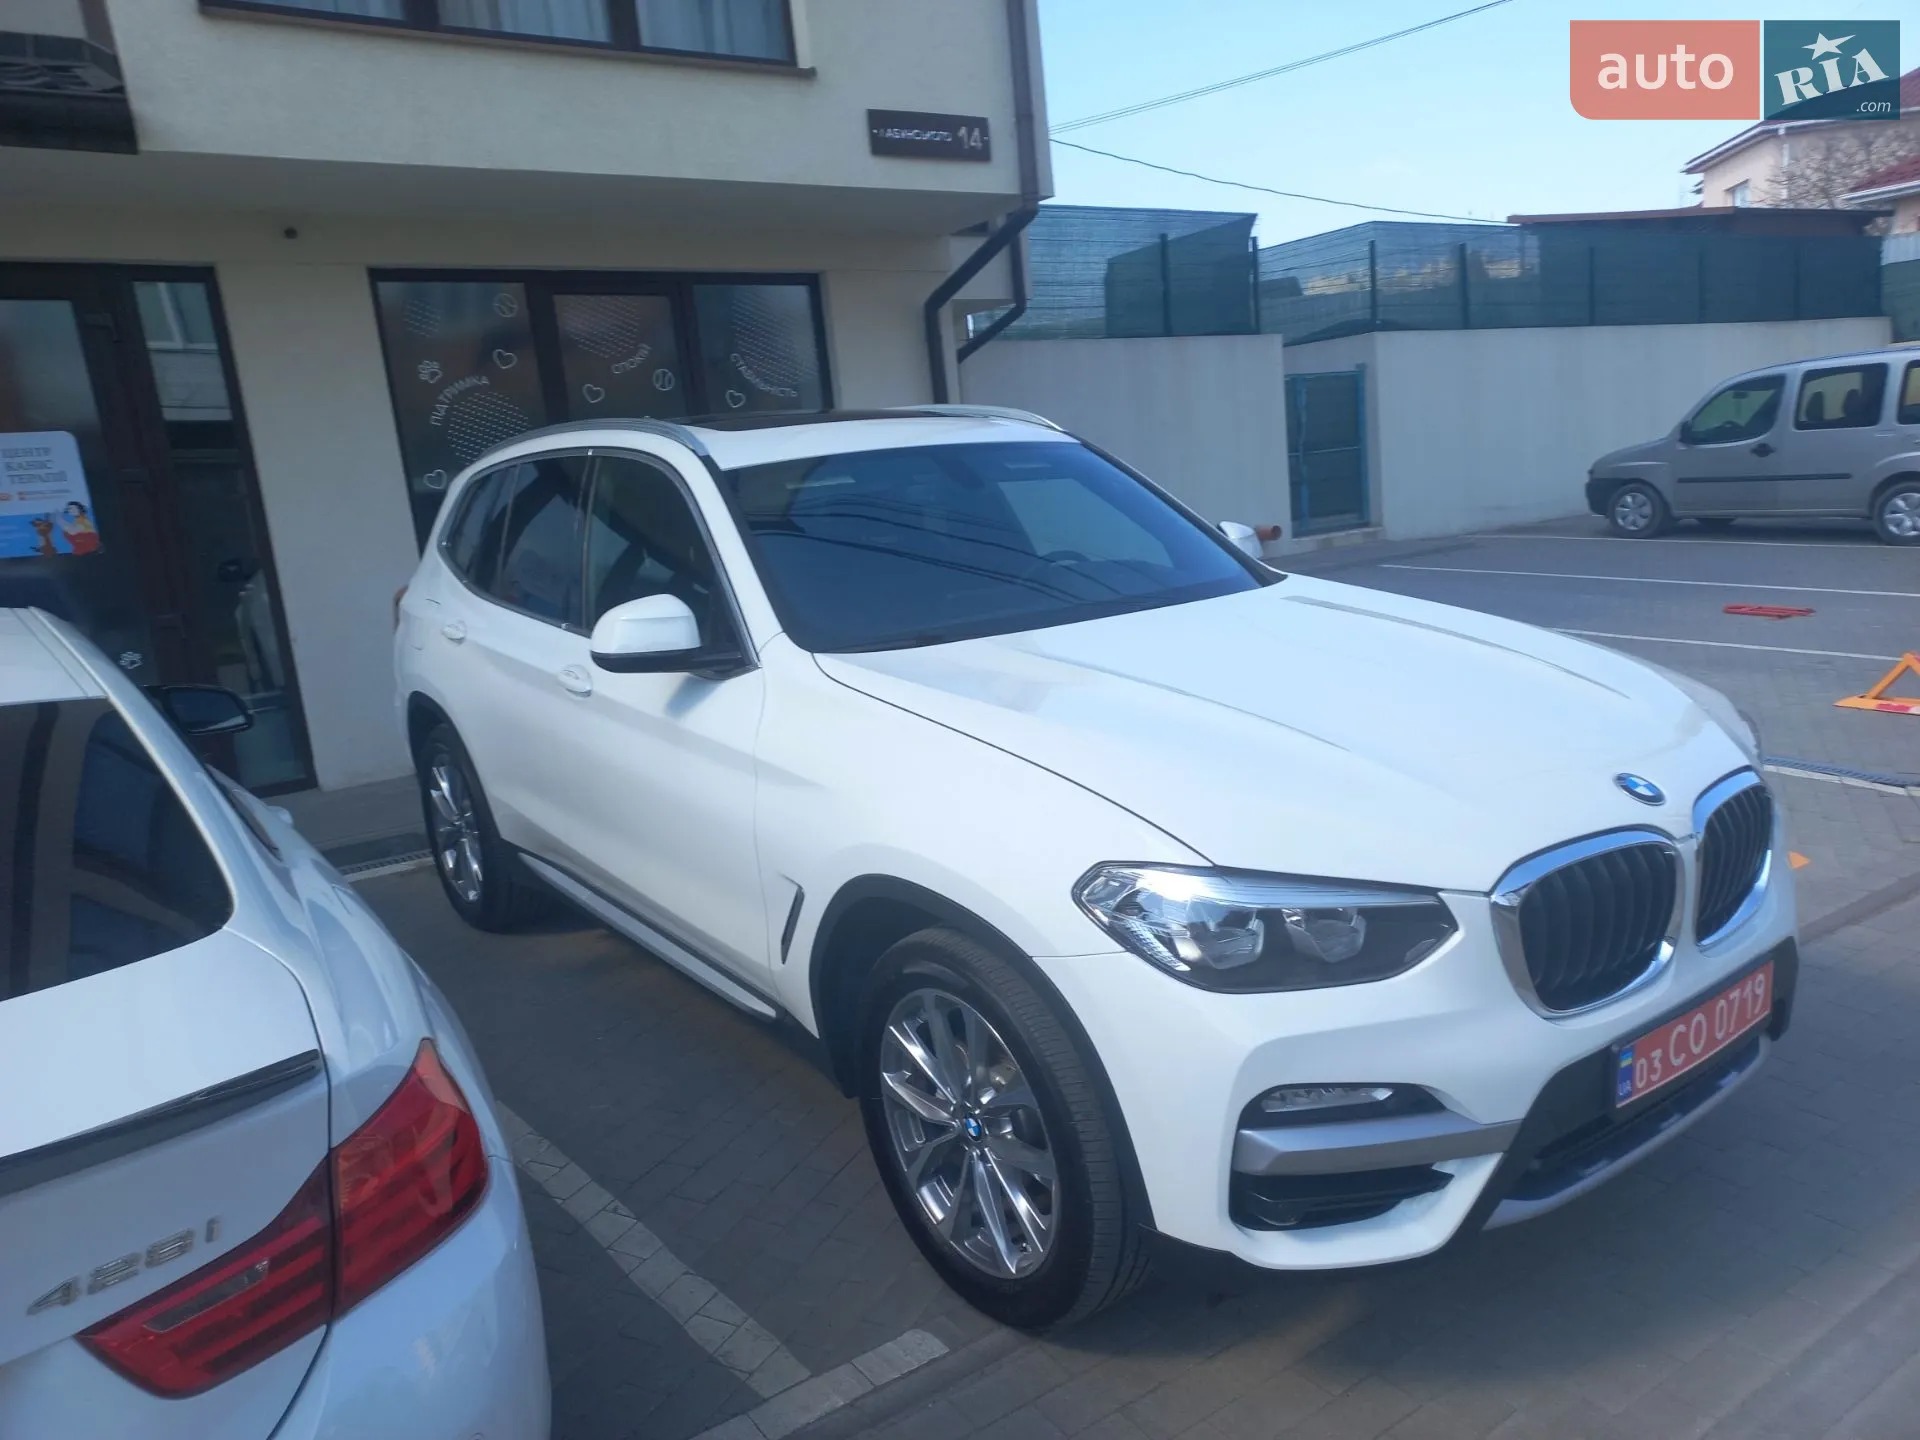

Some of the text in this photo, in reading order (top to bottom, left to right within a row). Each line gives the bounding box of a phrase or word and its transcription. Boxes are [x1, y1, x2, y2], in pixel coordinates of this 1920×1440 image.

[957, 126, 983, 151] 14
[1636, 1048, 1664, 1089] 03
[1714, 972, 1766, 1040] 0719
[1619, 1081, 1632, 1096] UA
[26, 1214, 222, 1316] 428i
